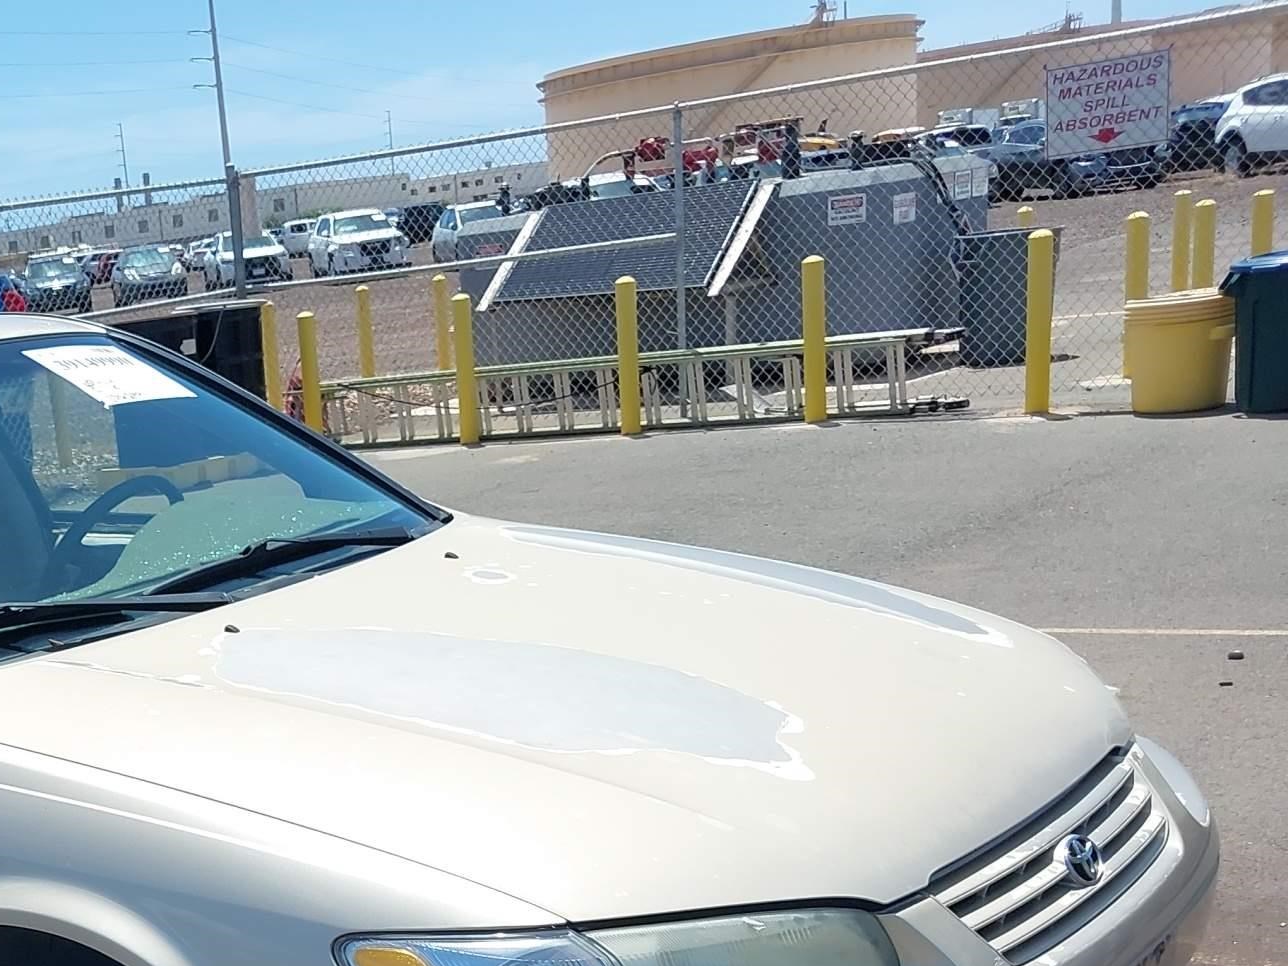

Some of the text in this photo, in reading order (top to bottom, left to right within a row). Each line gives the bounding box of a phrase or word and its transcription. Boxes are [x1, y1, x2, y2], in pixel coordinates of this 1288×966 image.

[1052, 55, 1164, 85] HAZARDOUS
[1058, 73, 1157, 101] MATERIALS
[1083, 95, 1130, 113] SPILL
[1054, 106, 1162, 133] ABSORBENT
